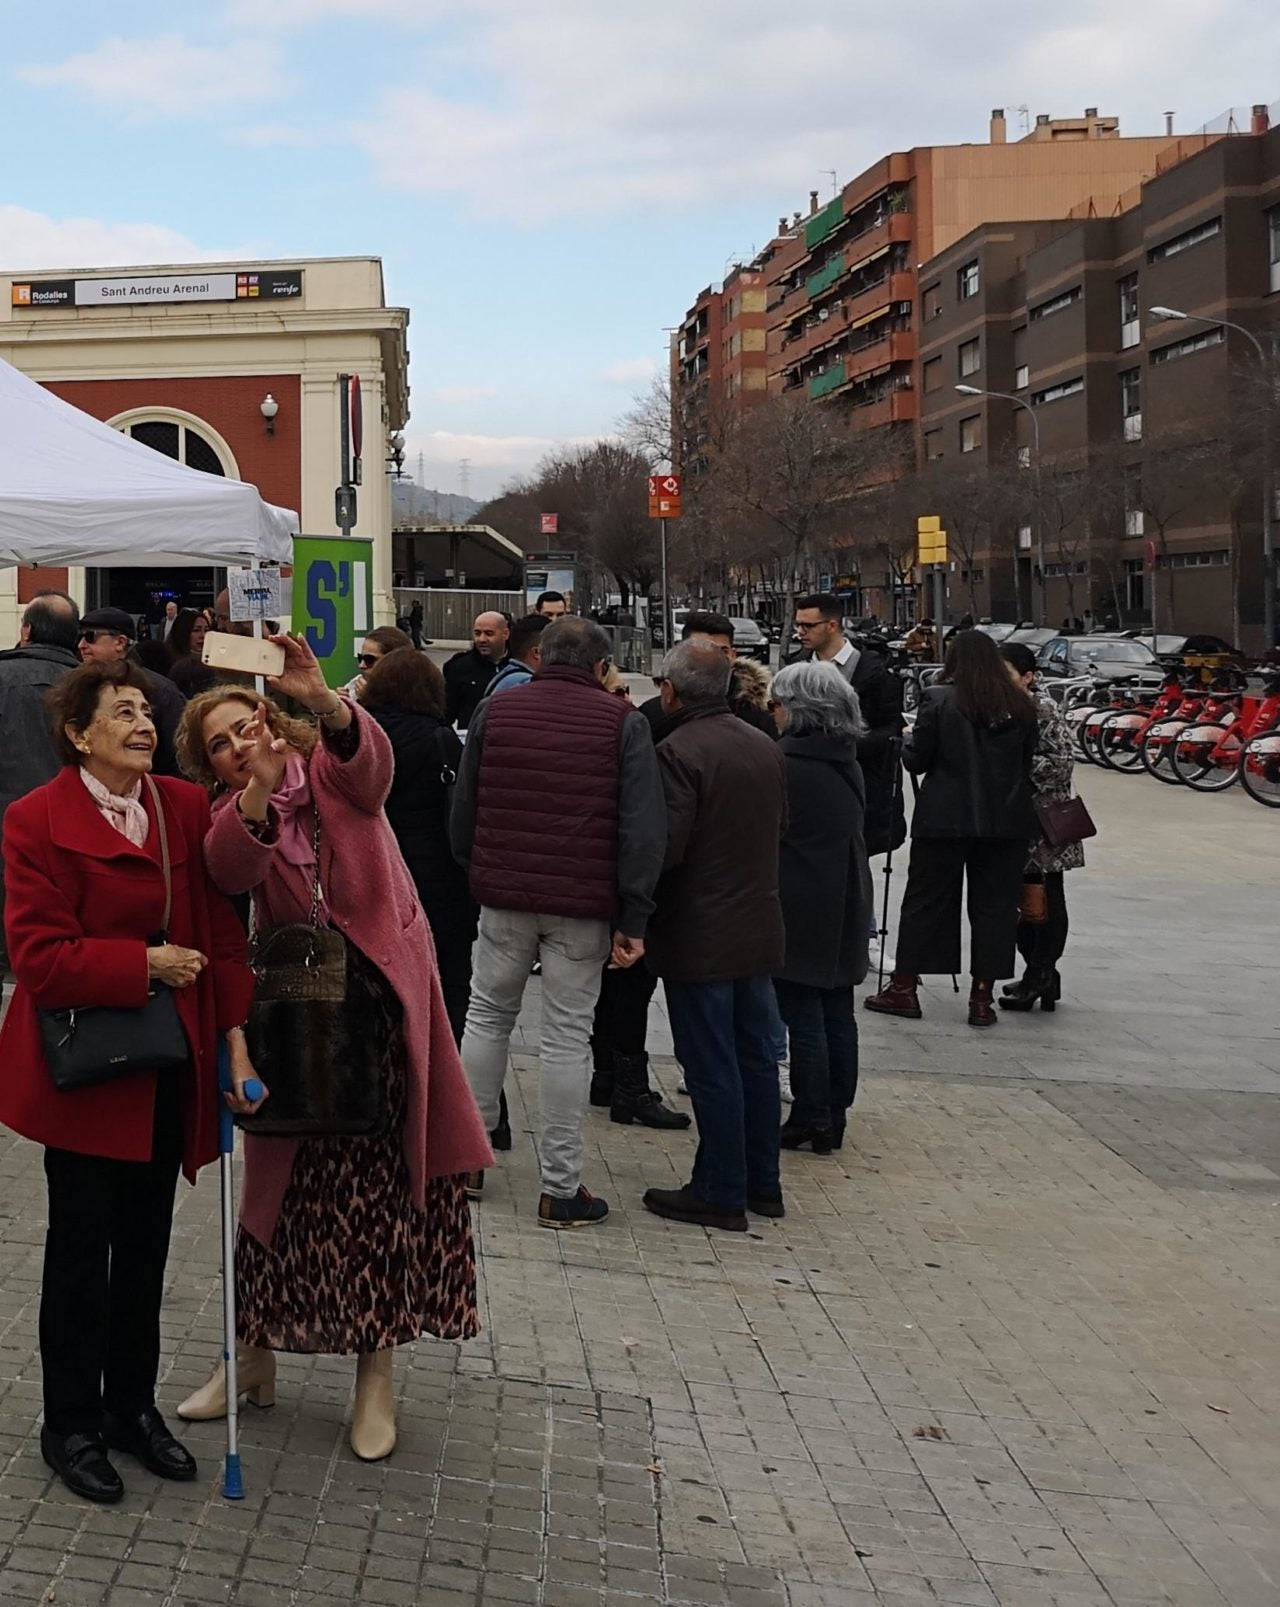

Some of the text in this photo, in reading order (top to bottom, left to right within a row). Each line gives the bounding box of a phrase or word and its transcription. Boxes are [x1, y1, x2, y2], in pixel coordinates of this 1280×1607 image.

[32, 290, 68, 300] Rodalies
[101, 282, 209, 297] Sant Andreu Arenal
[272, 284, 299, 295] renfe
